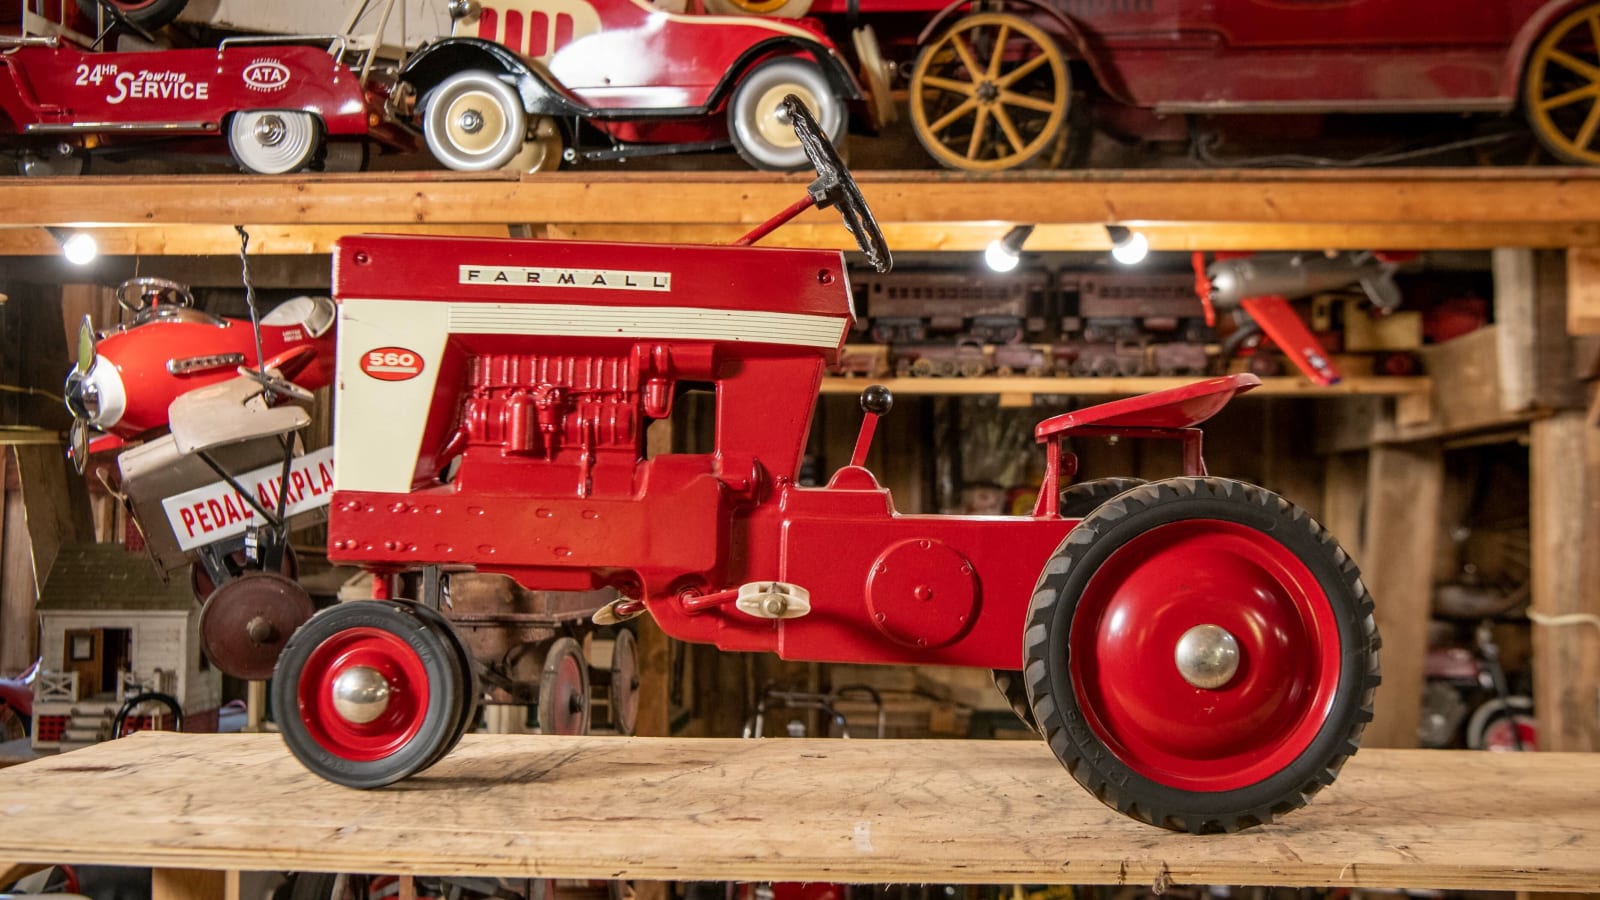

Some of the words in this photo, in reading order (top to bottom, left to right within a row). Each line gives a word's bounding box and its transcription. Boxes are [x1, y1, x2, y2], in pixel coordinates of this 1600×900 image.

[138, 70, 186, 83] Towing
[251, 68, 282, 81] ATA
[106, 72, 209, 104] SERVICE
[468, 270, 665, 288] FARMALL
[369, 353, 415, 366] 560
[180, 489, 254, 538] PEDAL
[257, 458, 334, 511] AIRPLA
